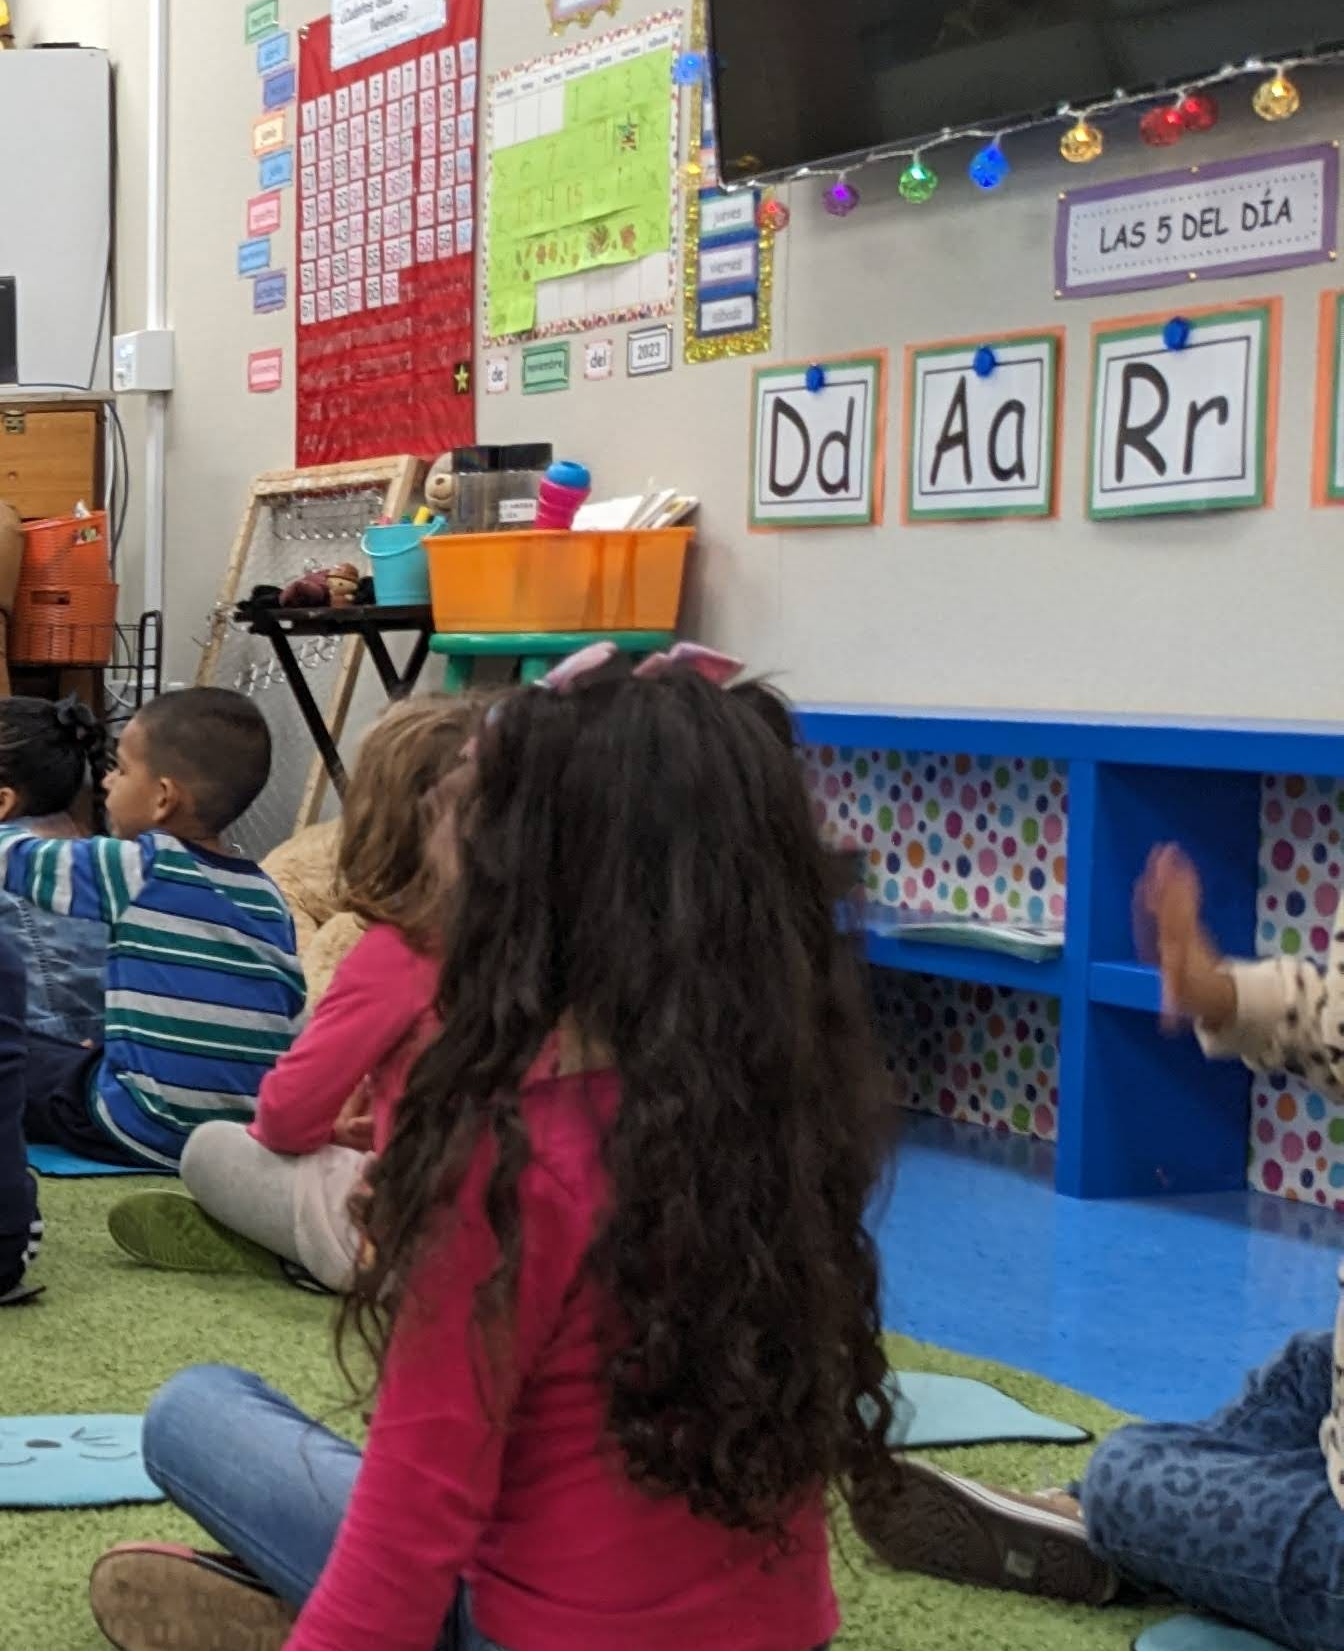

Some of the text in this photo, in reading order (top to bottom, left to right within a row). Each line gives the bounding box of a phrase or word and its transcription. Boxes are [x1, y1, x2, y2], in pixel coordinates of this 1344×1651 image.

[1099, 187, 1293, 254] LAS 5 DEL DÍA
[637, 342, 661, 360] 2023
[767, 395, 856, 497] Dd
[929, 375, 1027, 487] Aa
[1115, 362, 1229, 483] Rr
